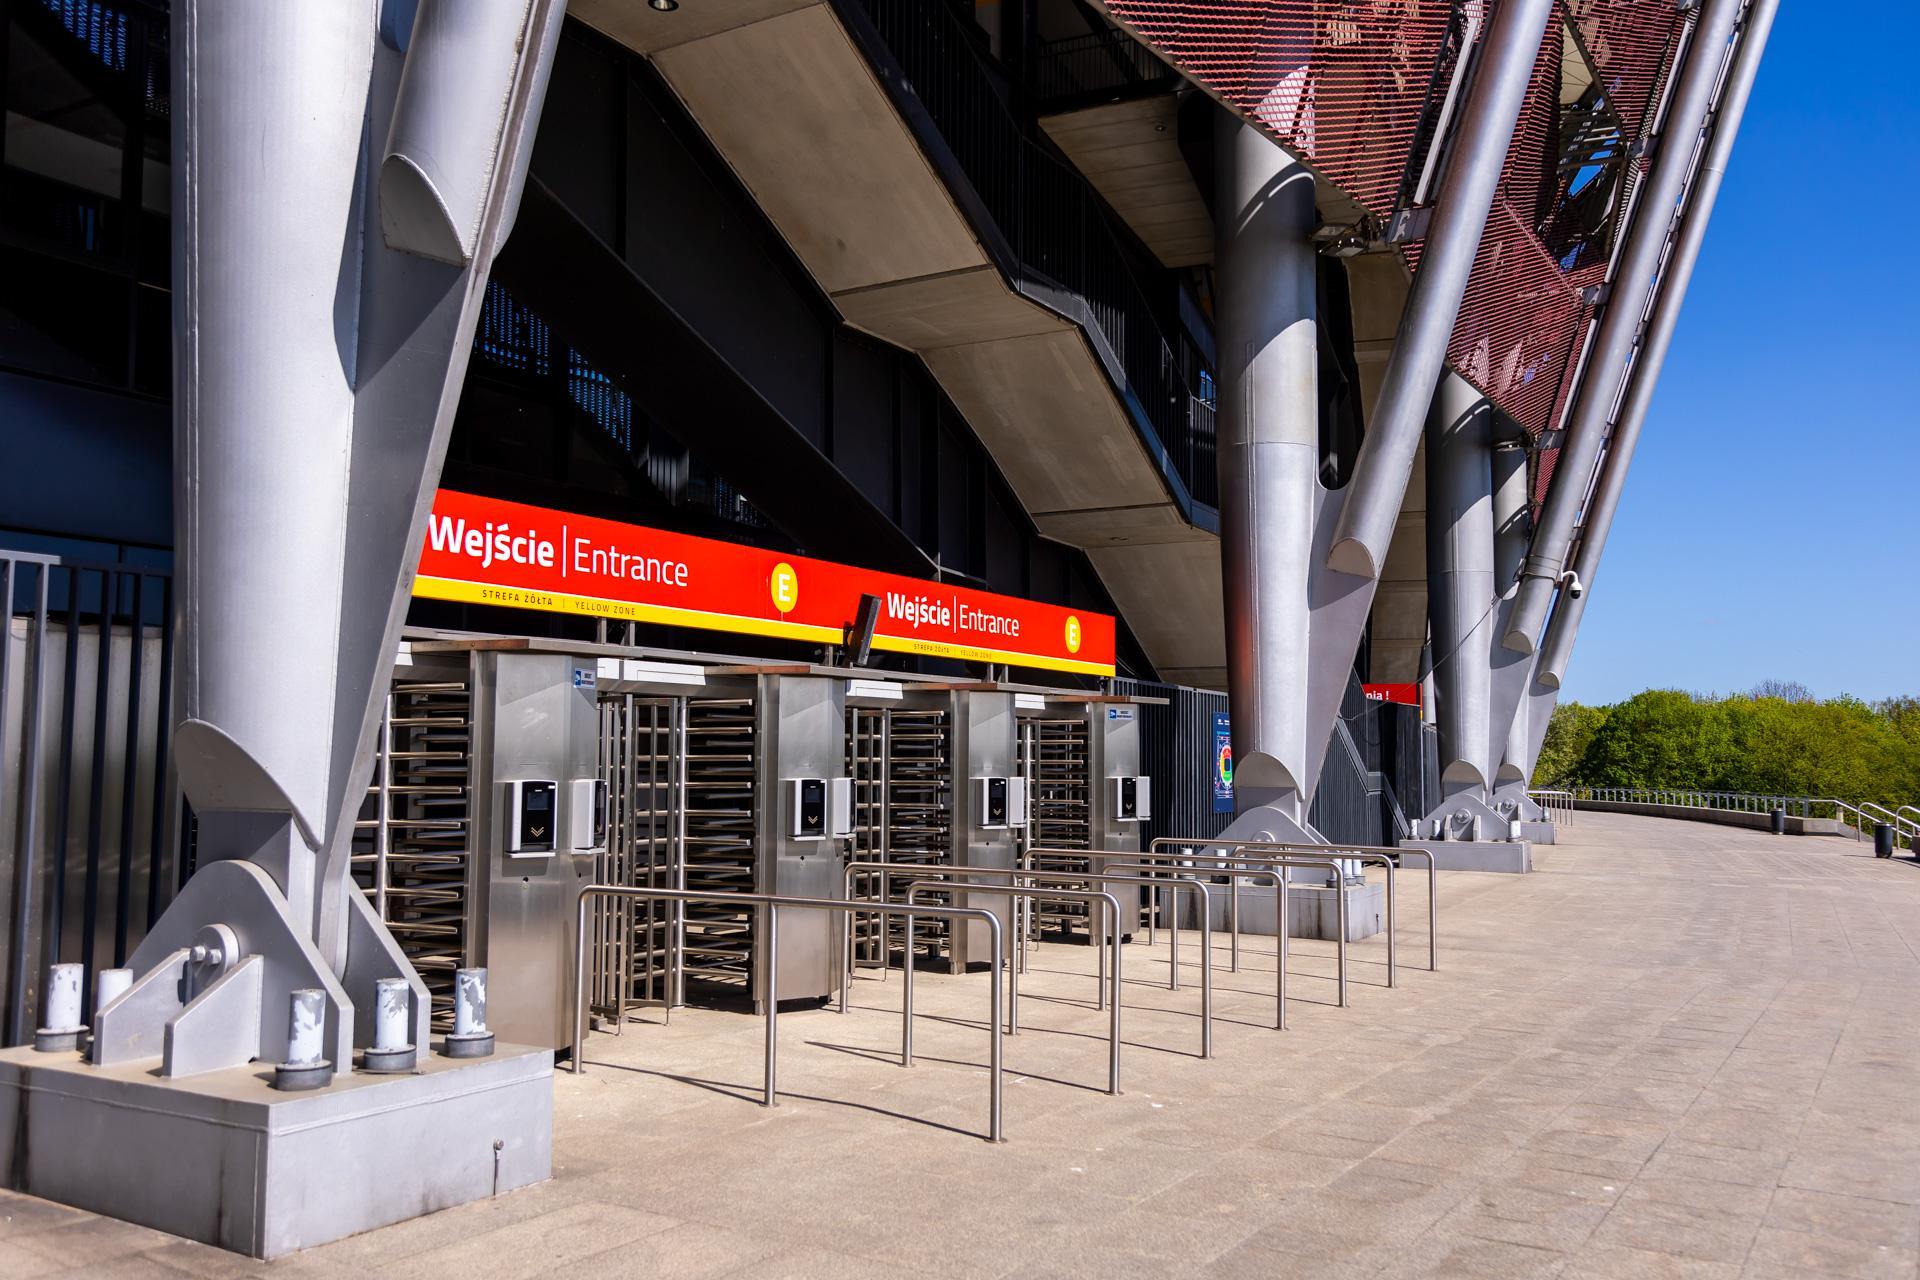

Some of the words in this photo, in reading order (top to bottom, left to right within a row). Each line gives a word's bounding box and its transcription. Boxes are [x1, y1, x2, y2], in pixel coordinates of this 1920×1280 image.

[429, 513, 555, 569] Wejście
[574, 537, 689, 587] Entrance
[482, 588, 520, 602] STREFA
[524, 593, 553, 606] ŻÓŁTA
[575, 600, 610, 613] YELLOW
[613, 605, 636, 616] ZONE
[778, 573, 791, 603] E
[886, 591, 951, 629] Wejście
[959, 604, 1020, 637] Entrance
[1069, 623, 1078, 646] E
